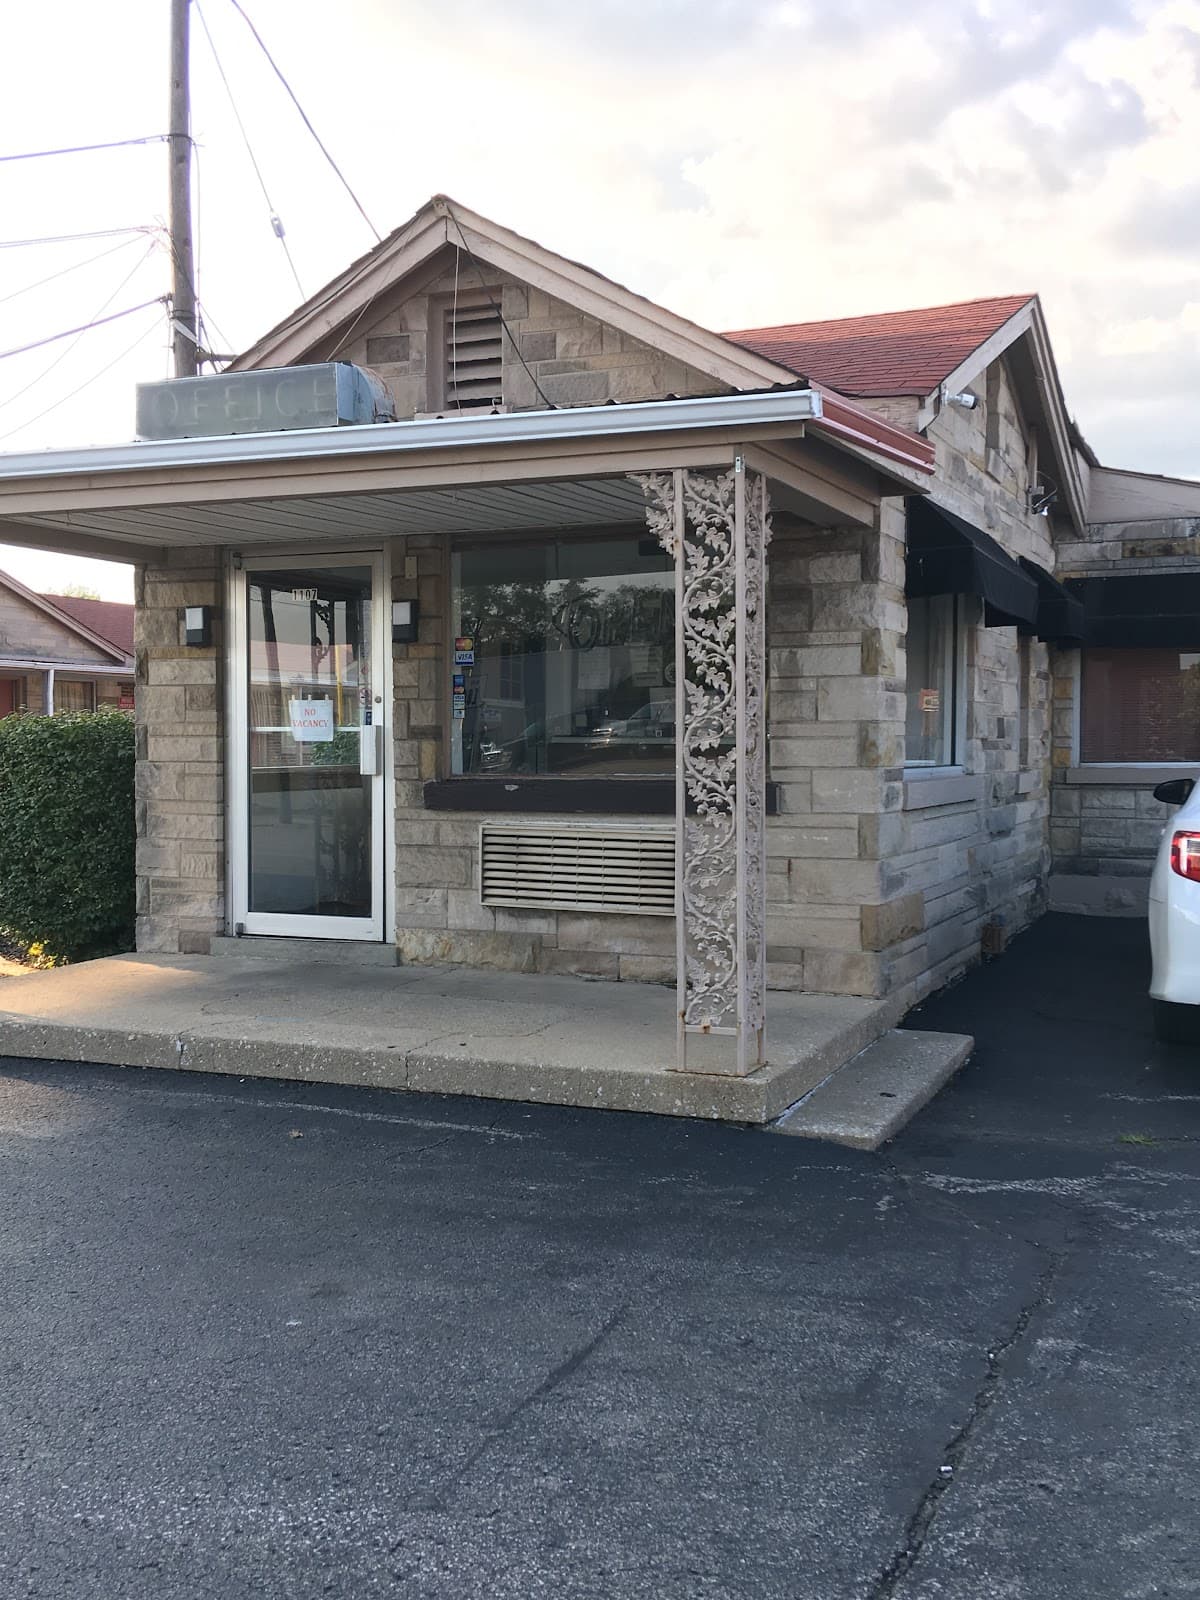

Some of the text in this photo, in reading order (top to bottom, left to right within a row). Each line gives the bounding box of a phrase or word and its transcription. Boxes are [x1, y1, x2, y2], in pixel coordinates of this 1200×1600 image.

[293, 590, 317, 601] 1107
[457, 653, 473, 661] VISA
[304, 707, 316, 716] NO
[292, 719, 329, 728] VACANCY
